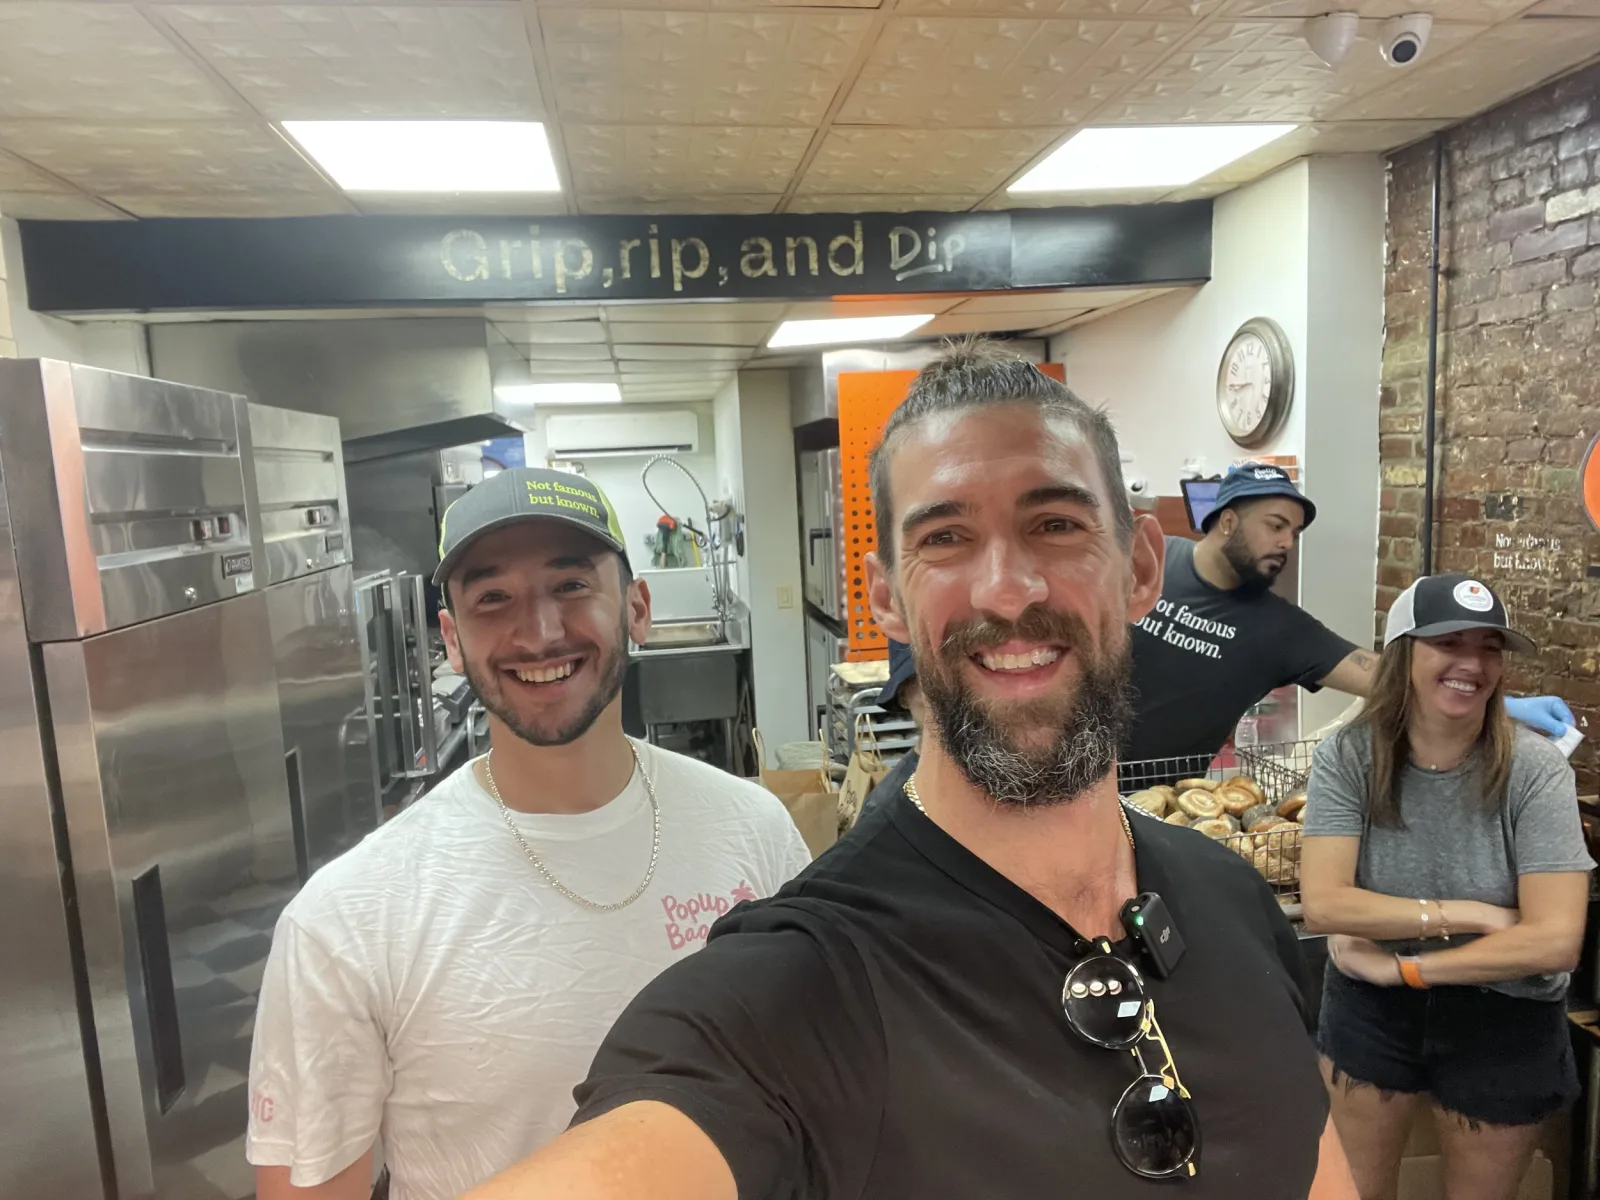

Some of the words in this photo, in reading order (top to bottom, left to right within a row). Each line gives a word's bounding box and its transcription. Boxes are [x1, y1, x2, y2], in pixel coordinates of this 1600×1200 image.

[739, 220, 864, 279] and
[888, 226, 966, 275] Dip
[526, 480, 551, 490] Not
[529, 494, 554, 504] but
[557, 496, 599, 518] known.
[1156, 594, 1175, 617] ot
[1173, 604, 1237, 640] famous
[1162, 622, 1222, 659] known.
